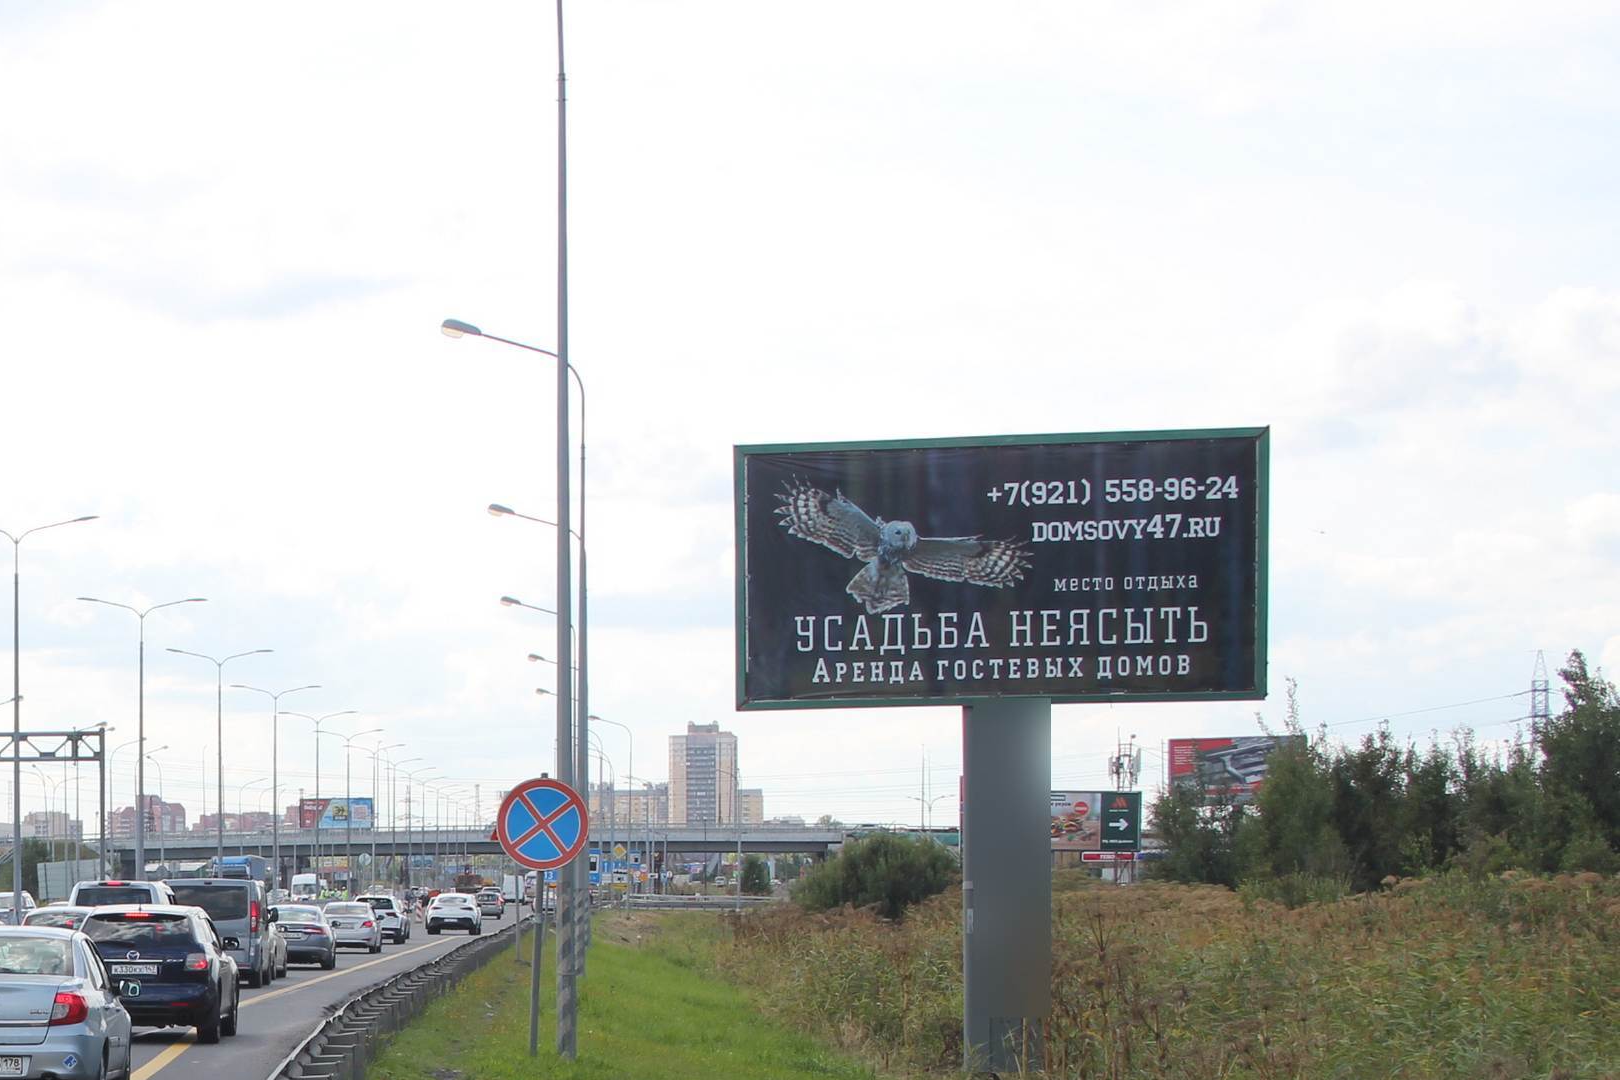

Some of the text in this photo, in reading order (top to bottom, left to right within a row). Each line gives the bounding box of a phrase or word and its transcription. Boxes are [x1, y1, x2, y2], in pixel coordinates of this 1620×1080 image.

[987, 476, 1239, 507] +7(921) 558-96-24
[1032, 514, 1221, 542] DOMSOVY47.RU
[1054, 575, 1199, 592] место отдыха
[794, 606, 1208, 655] УСАДЬБА НЕЯСЫТЬ
[3, 1058, 20, 1067] 178
